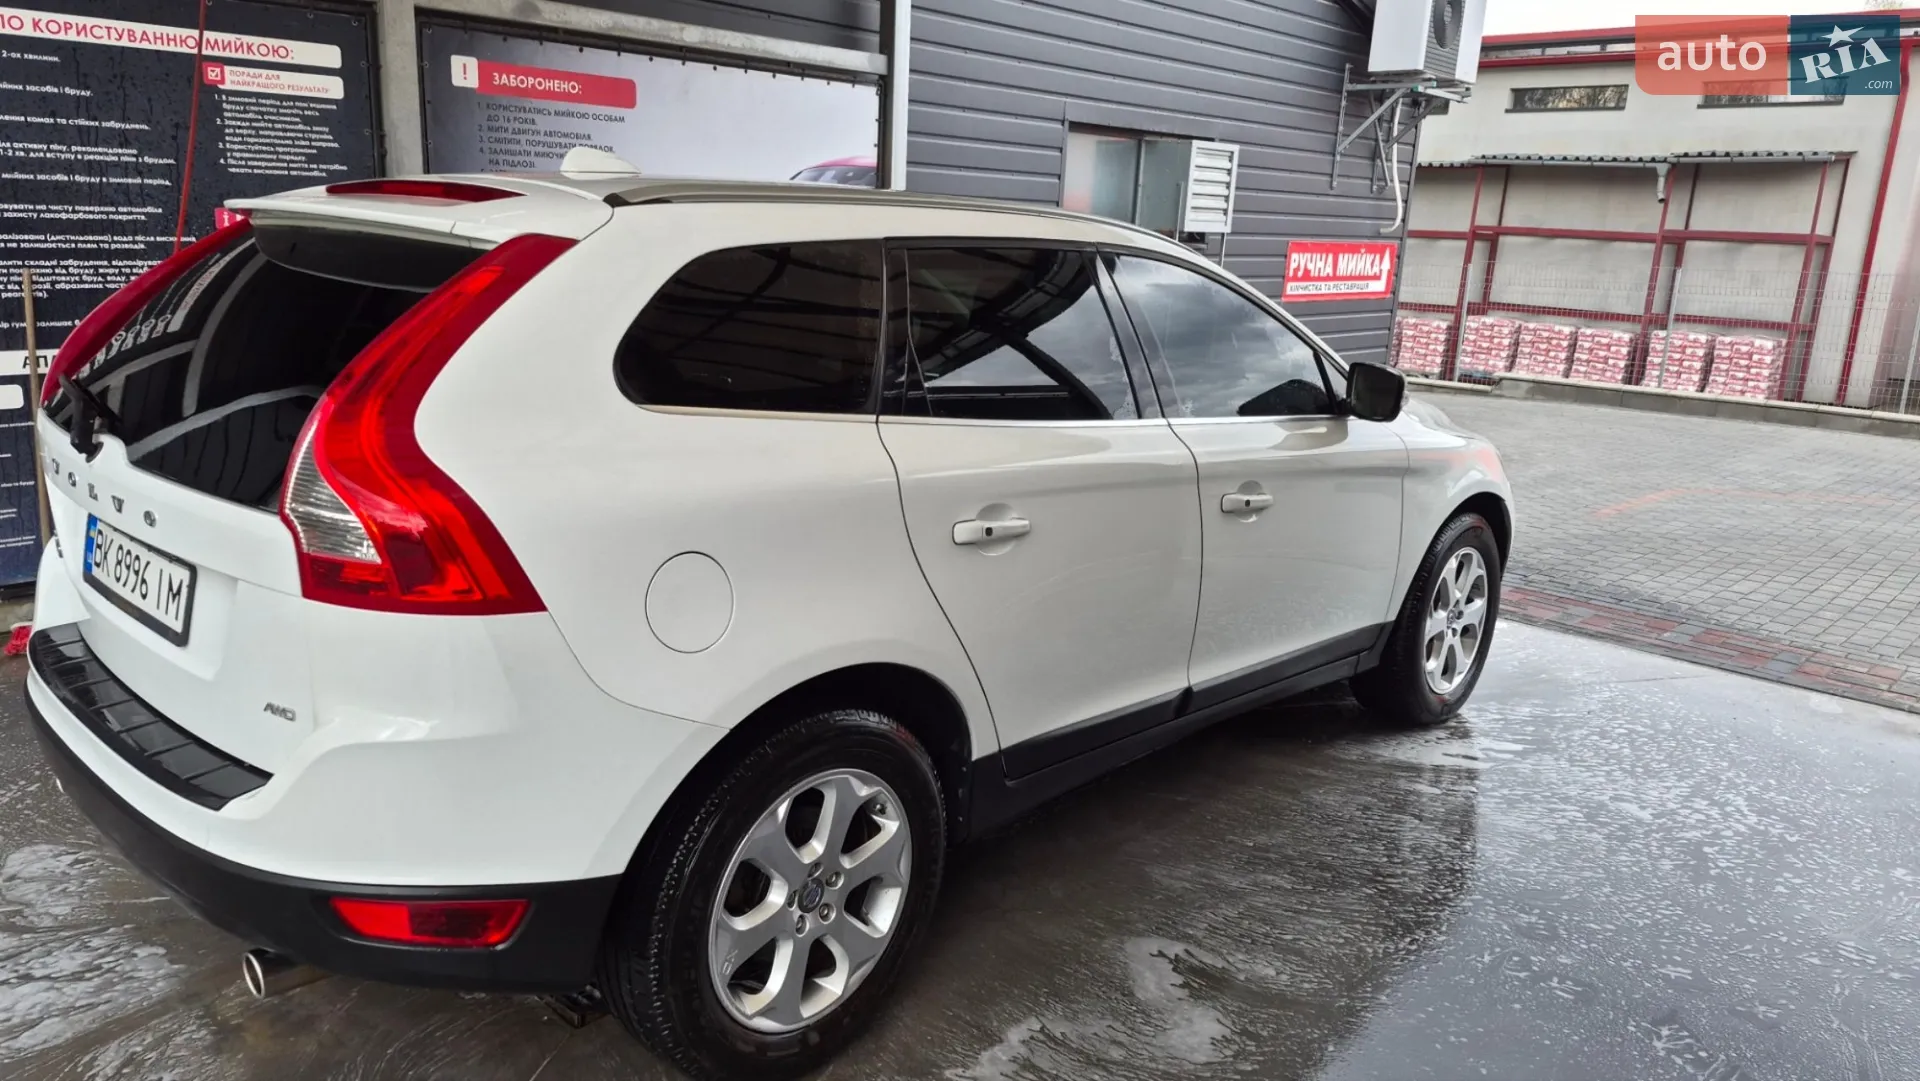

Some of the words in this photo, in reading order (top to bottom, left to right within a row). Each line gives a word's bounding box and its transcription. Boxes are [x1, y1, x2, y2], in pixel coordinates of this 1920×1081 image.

[32, 17, 199, 49] КОРИСТУВАННЮ
[205, 37, 294, 60] МИЙКОЮ:
[229, 69, 263, 79] ПОРАДИ
[287, 84, 329, 94] РЕЗУЛЬТАТУ
[493, 72, 582, 95] ЗАБОРОНЕНО:
[485, 102, 552, 116] КОРИСТУВАТИСЬ
[553, 108, 590, 120] МИЙКОЮ
[591, 112, 626, 123] ОСОБАМ
[486, 113, 500, 122] ДО
[502, 114, 511, 123] 16
[513, 116, 537, 126] РОКІВ.
[487, 125, 509, 135] МИТИ
[511, 127, 541, 137] ДВИГУН
[543, 129, 593, 141] АВТОМОБІЛЯ.
[488, 146, 532, 157] ЗАЛИШАТИ
[525, 138, 577, 150] ПОРУШУВАТИ
[488, 157, 500, 166] НА
[1288, 252, 1333, 278] РУЧНА
[1336, 248, 1381, 277] МИЙКА
[93, 528, 114, 578] BK
[114, 543, 151, 601] 8996
[156, 567, 184, 621] IM
[263, 701, 297, 722] AWD
